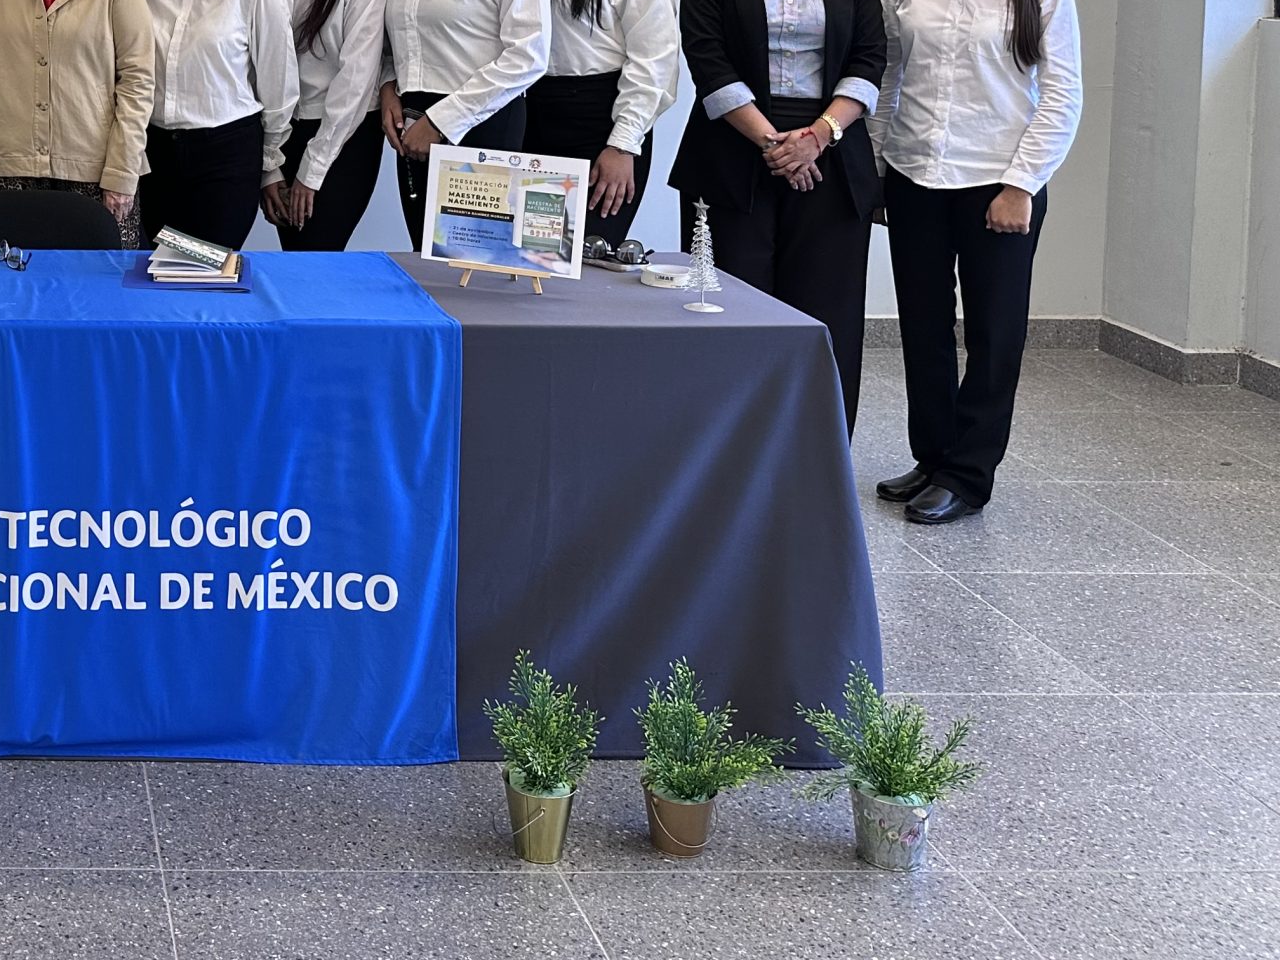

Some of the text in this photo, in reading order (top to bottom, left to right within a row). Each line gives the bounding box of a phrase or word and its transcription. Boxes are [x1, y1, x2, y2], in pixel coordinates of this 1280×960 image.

[449, 177, 508, 189] PRESENTACIÓN
[448, 191, 487, 201] MAESTRA
[448, 198, 500, 209] NACIMIENTO
[0, 497, 311, 550] TECNOLÓGICO
[160, 572, 214, 610] DE
[227, 558, 399, 613] MÉXICO
